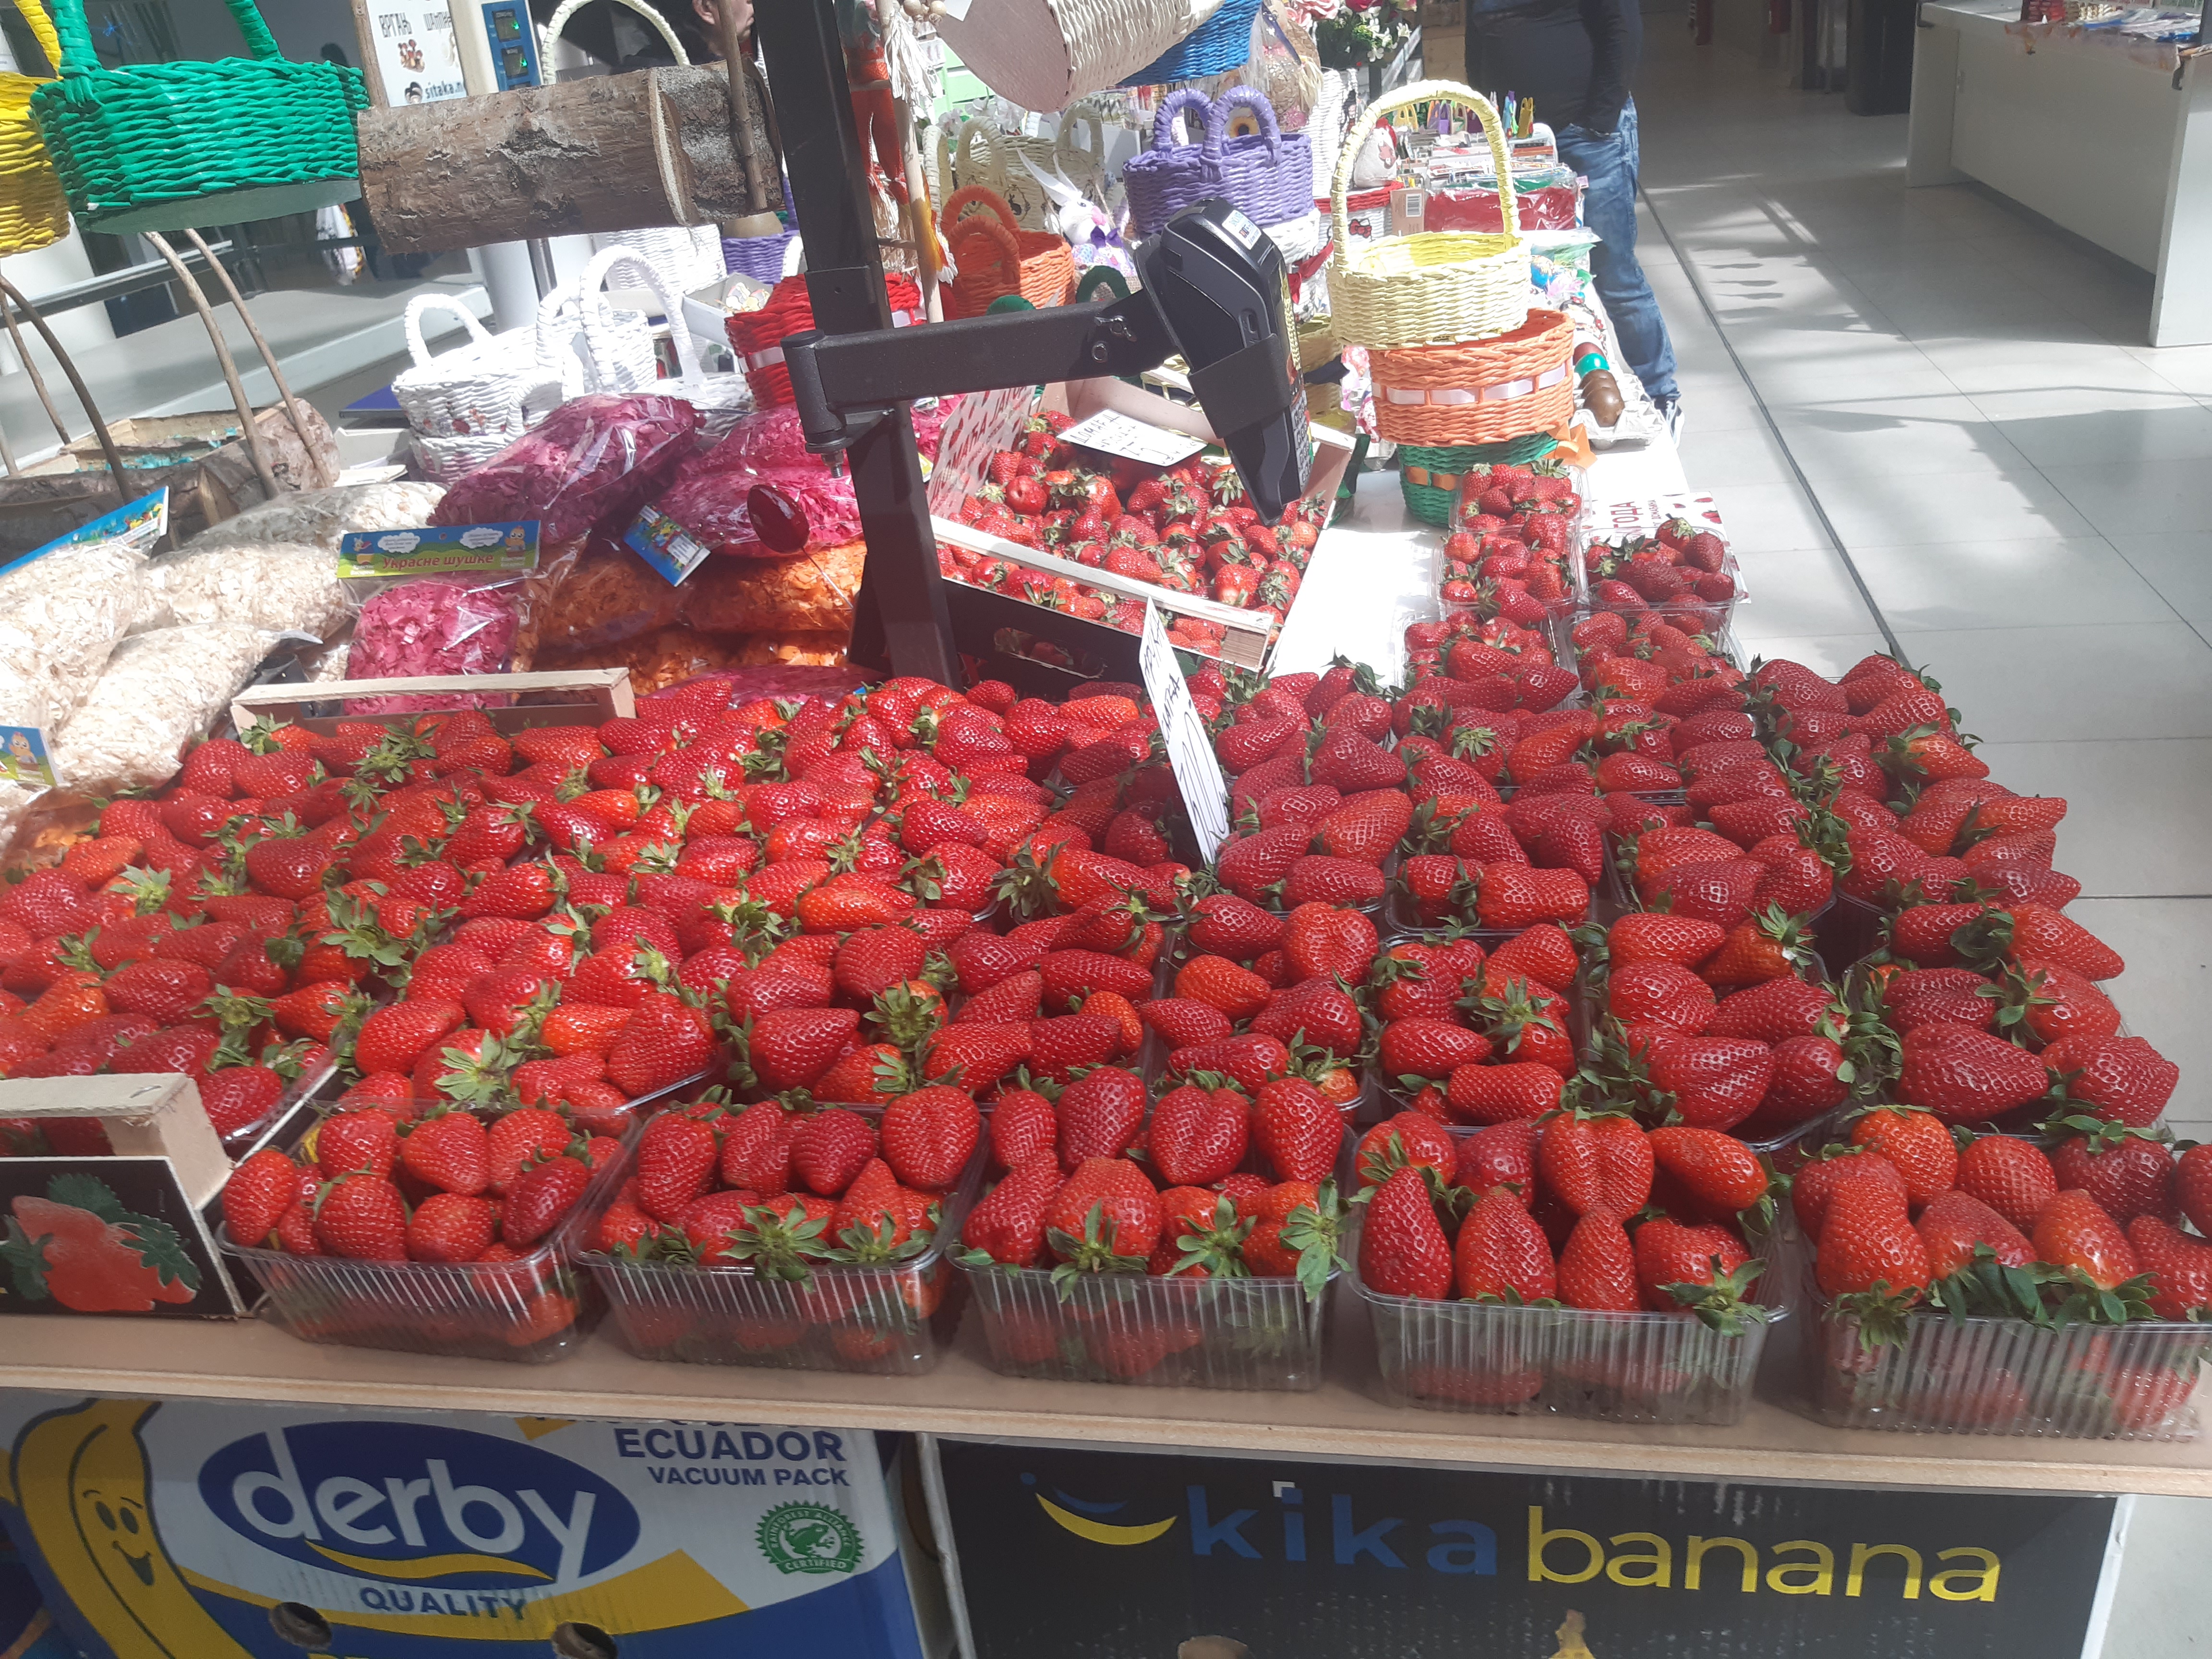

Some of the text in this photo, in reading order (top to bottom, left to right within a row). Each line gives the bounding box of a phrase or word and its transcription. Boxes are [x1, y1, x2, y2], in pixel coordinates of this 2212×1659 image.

[383, 557, 439, 570] Украсне
[444, 554, 493, 565] шушке
[613, 1428, 847, 1461] ECUADOR
[647, 1467, 850, 1487] VACUUM PACK
[232, 1427, 596, 1583] derby
[1186, 1485, 2001, 1602] kika banana
[785, 1560, 847, 1570] CERTIFIED
[361, 1587, 527, 1620] QUALITY
